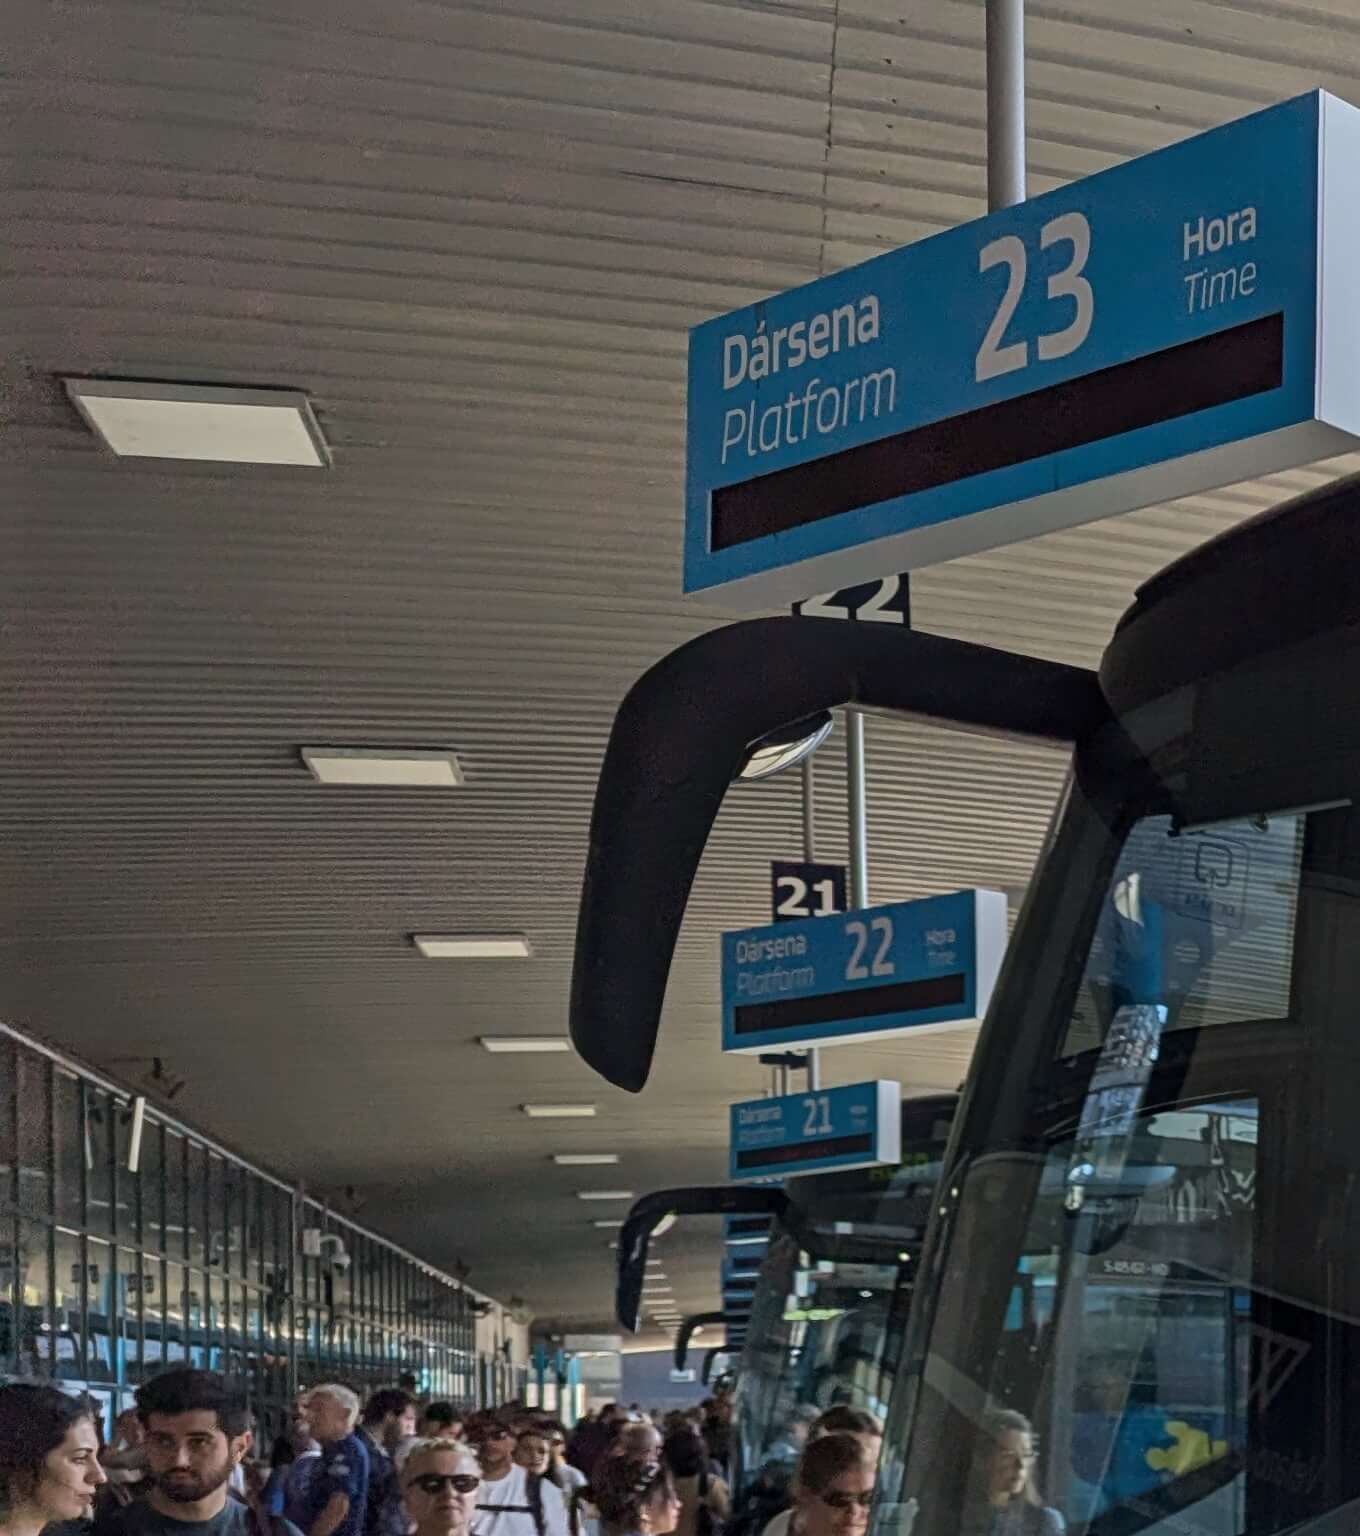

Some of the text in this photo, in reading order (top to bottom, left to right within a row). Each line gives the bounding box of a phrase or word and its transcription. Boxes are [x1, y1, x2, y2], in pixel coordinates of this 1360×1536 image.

[1184, 207, 1257, 261] Hora
[975, 211, 1094, 383] 23
[1184, 262, 1257, 314] Time
[722, 294, 880, 390] Dársena
[721, 367, 897, 465] Platform
[776, 876, 841, 917] 21
[735, 932, 807, 964] Dársena
[845, 916, 896, 980] 22
[803, 1097, 833, 1137] 21
